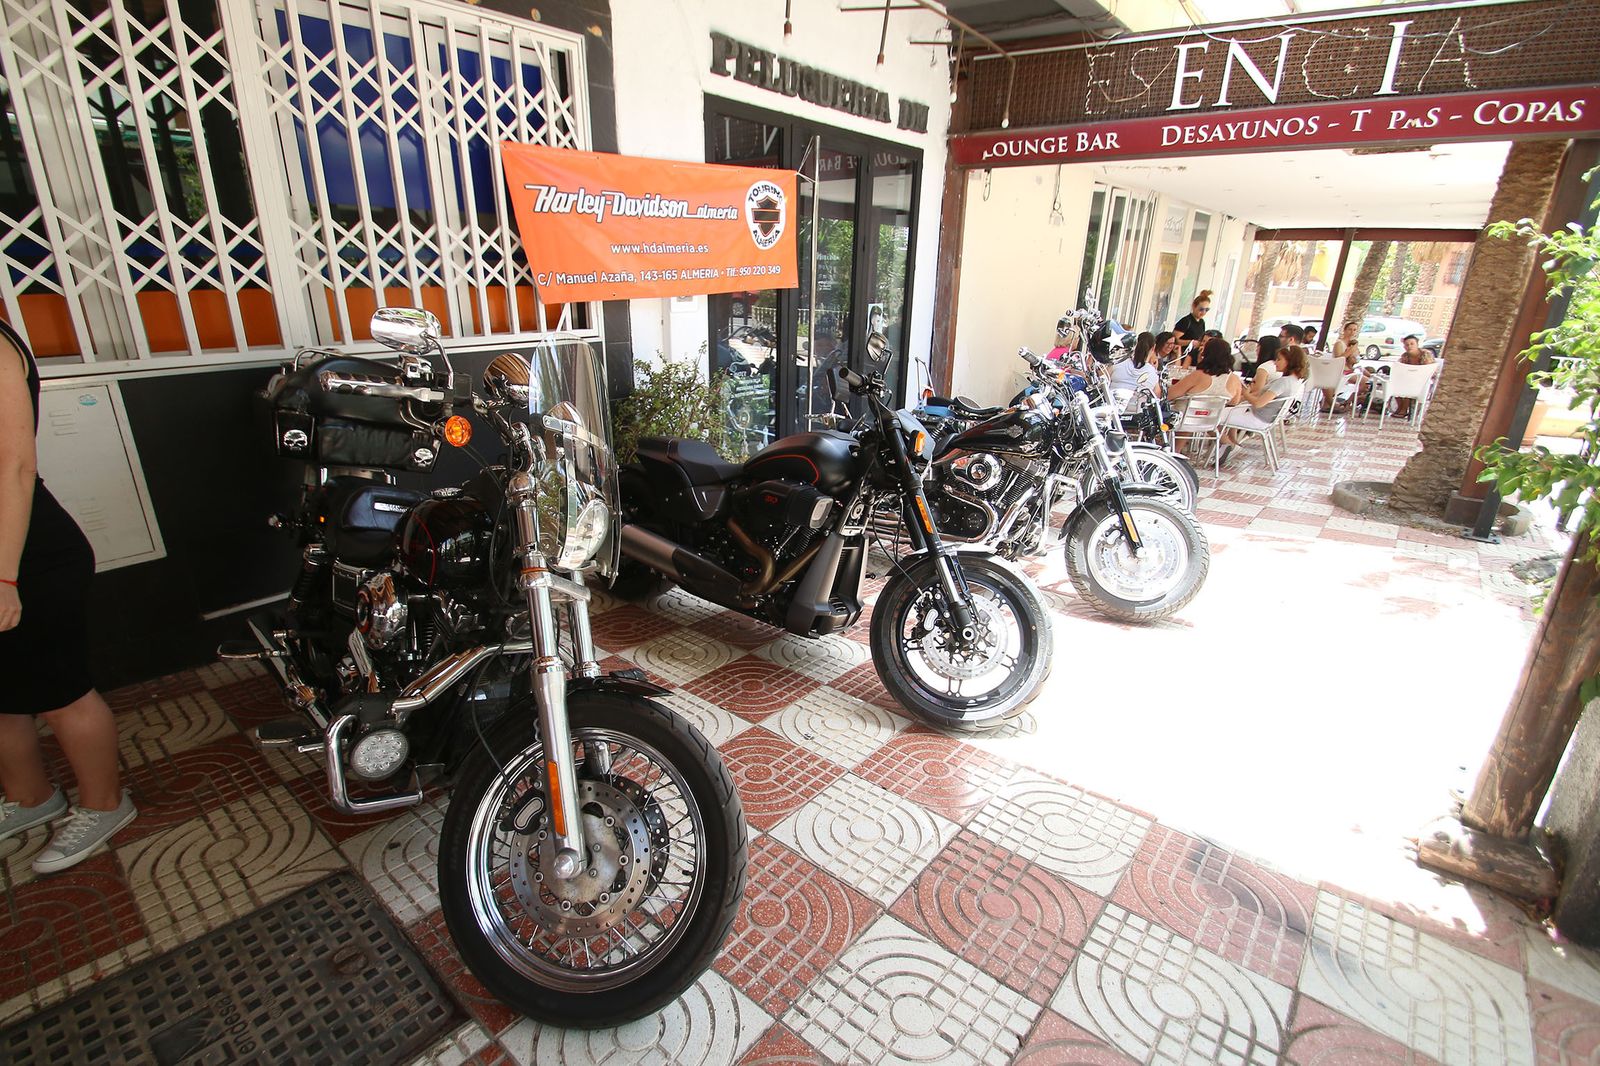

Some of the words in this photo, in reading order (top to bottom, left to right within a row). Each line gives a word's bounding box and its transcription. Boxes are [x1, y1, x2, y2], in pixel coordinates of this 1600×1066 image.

[709, 30, 891, 124] PELUQUERIA
[1161, 114, 1320, 147] DESAYUNOS
[1472, 99, 1586, 126] COPAS
[1075, 131, 1121, 153] BAR
[523, 183, 689, 223] Harley-Davidson
[610, 242, 709, 254] www.hdalmeria.es
[537, 272, 553, 287] C/
[556, 271, 598, 285] Manuel
[600, 269, 637, 283] Azaña,
[640, 269, 678, 281] 143-165
[680, 267, 720, 280] ALMERIA
[739, 266, 752, 276] 950
[752, 265, 766, 275] 220
[767, 265, 781, 275] 349
